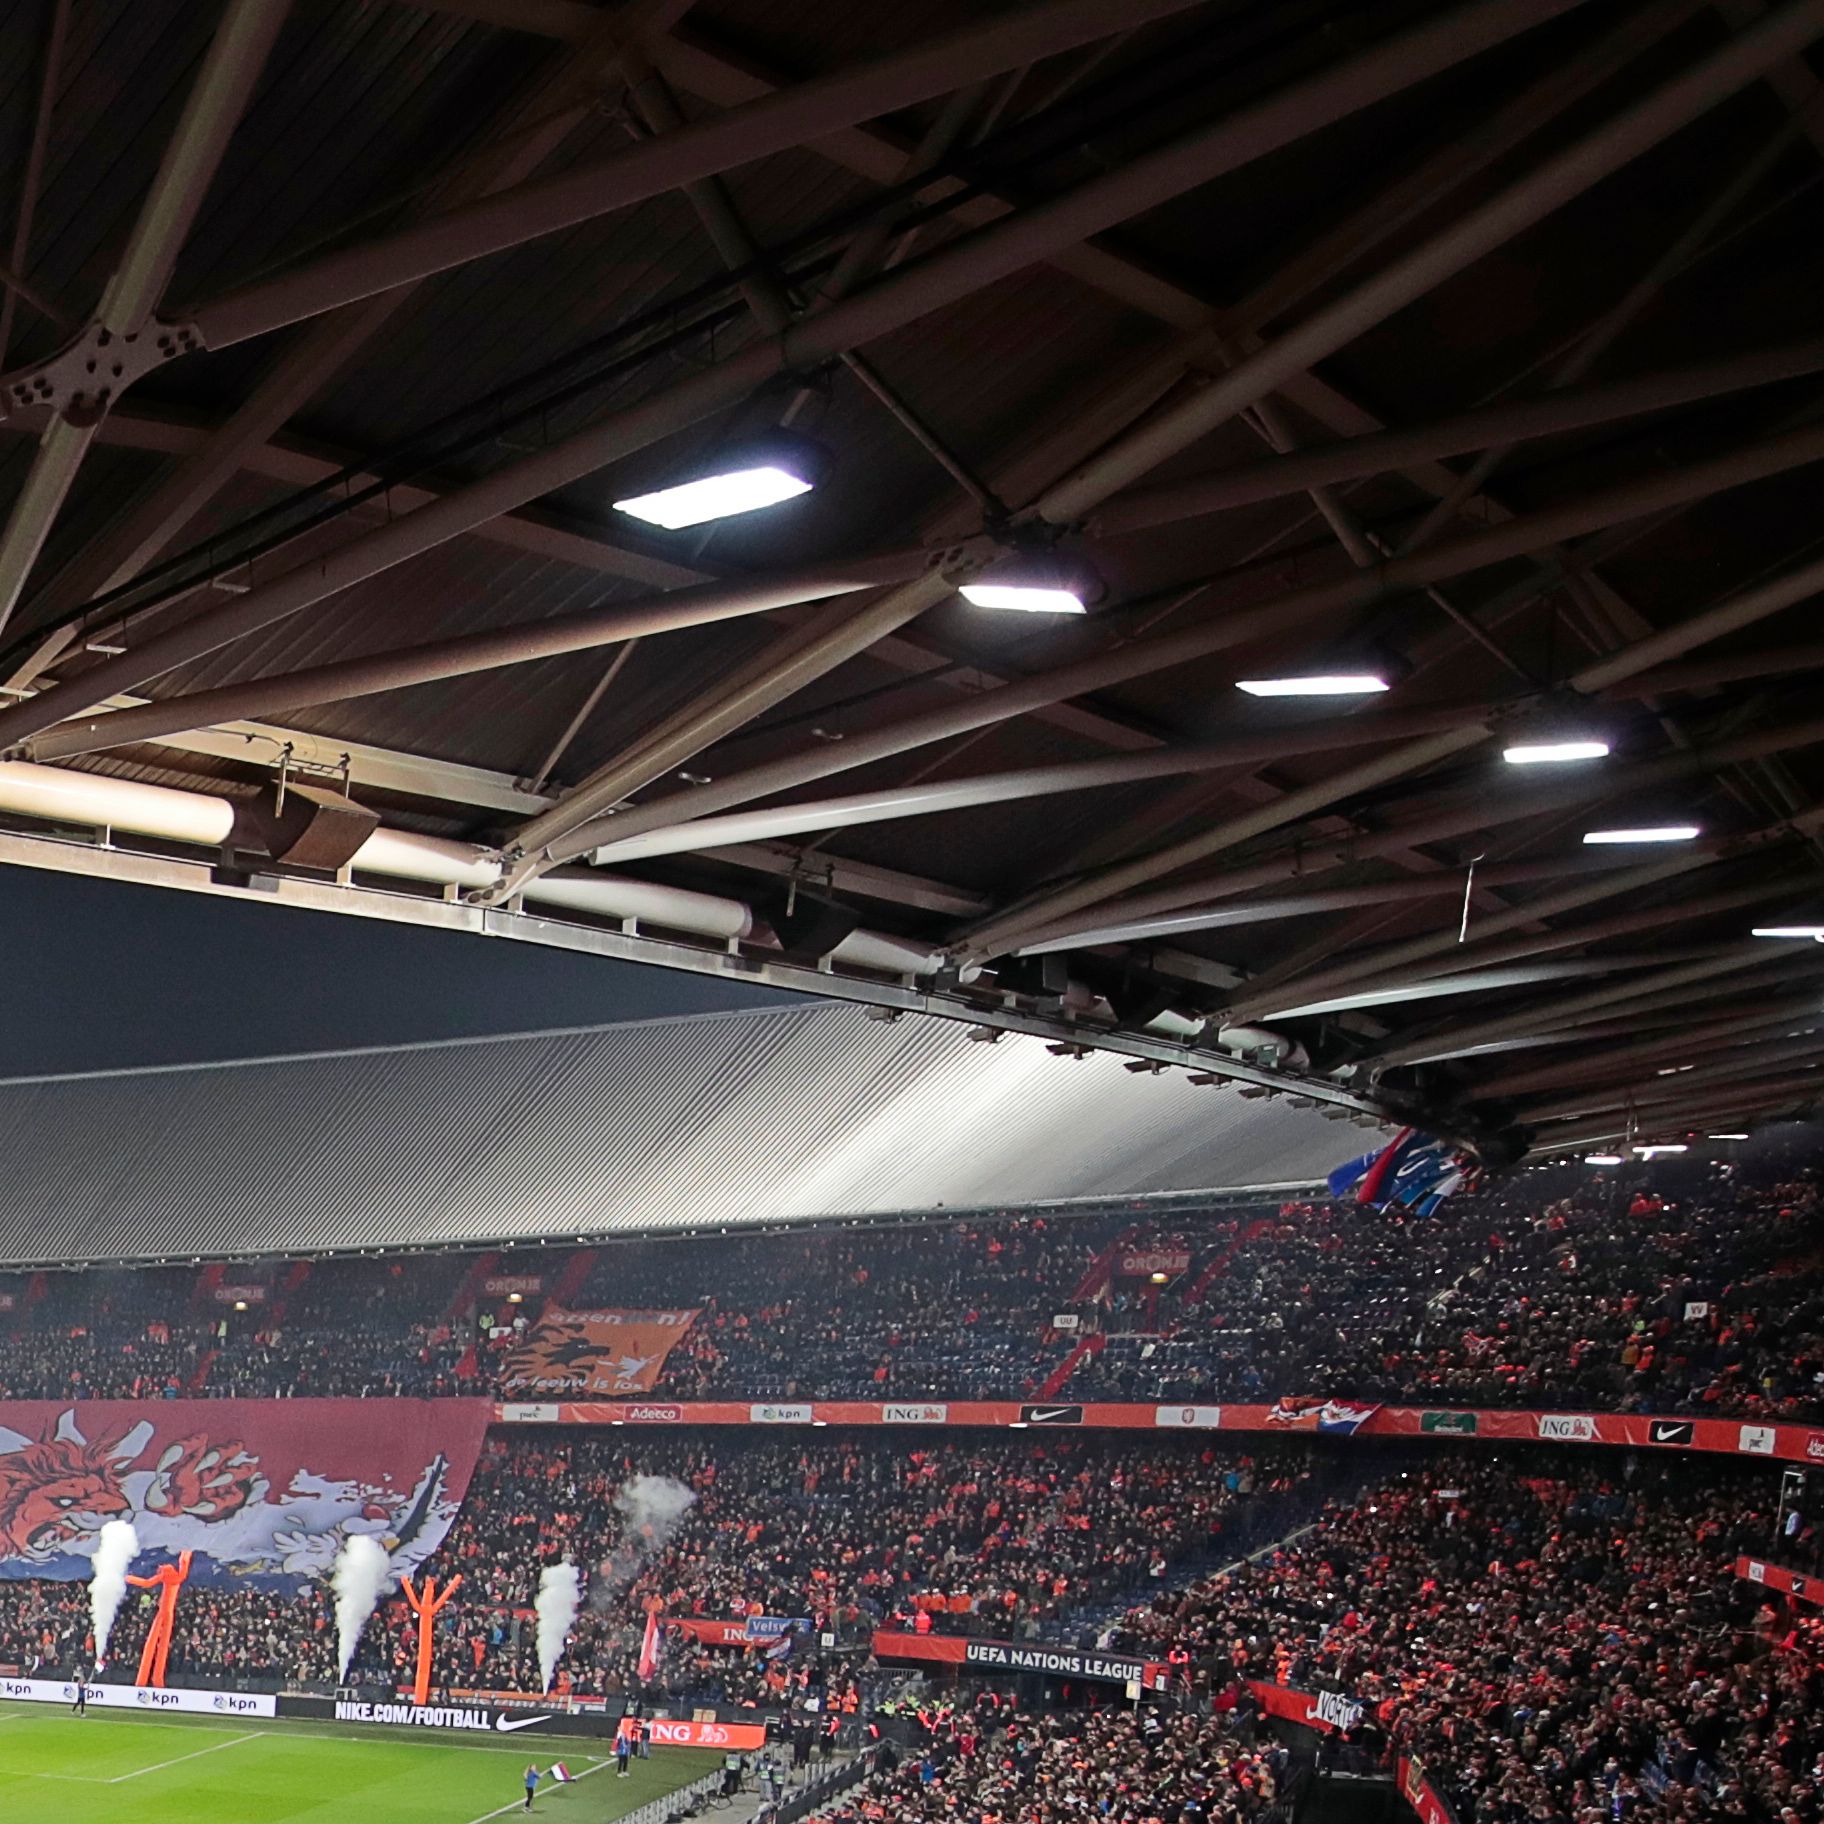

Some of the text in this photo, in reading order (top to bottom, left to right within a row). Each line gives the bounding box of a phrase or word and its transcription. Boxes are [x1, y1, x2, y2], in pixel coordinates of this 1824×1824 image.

[630, 1409, 676, 1422] Adecco
[778, 1409, 801, 1420] kpn
[887, 1407, 919, 1421] ING
[1542, 1419, 1570, 1436] ING
[967, 1646, 1143, 1682] UEFA NATIONS LEAGUE
[7, 1682, 31, 1695] kpn
[87, 1691, 104, 1703] pn
[153, 1692, 179, 1705] kpn
[230, 1697, 257, 1710] kpn
[335, 1701, 491, 1731] NIKE.COM/FOOTBALL
[650, 1724, 691, 1742] ING
